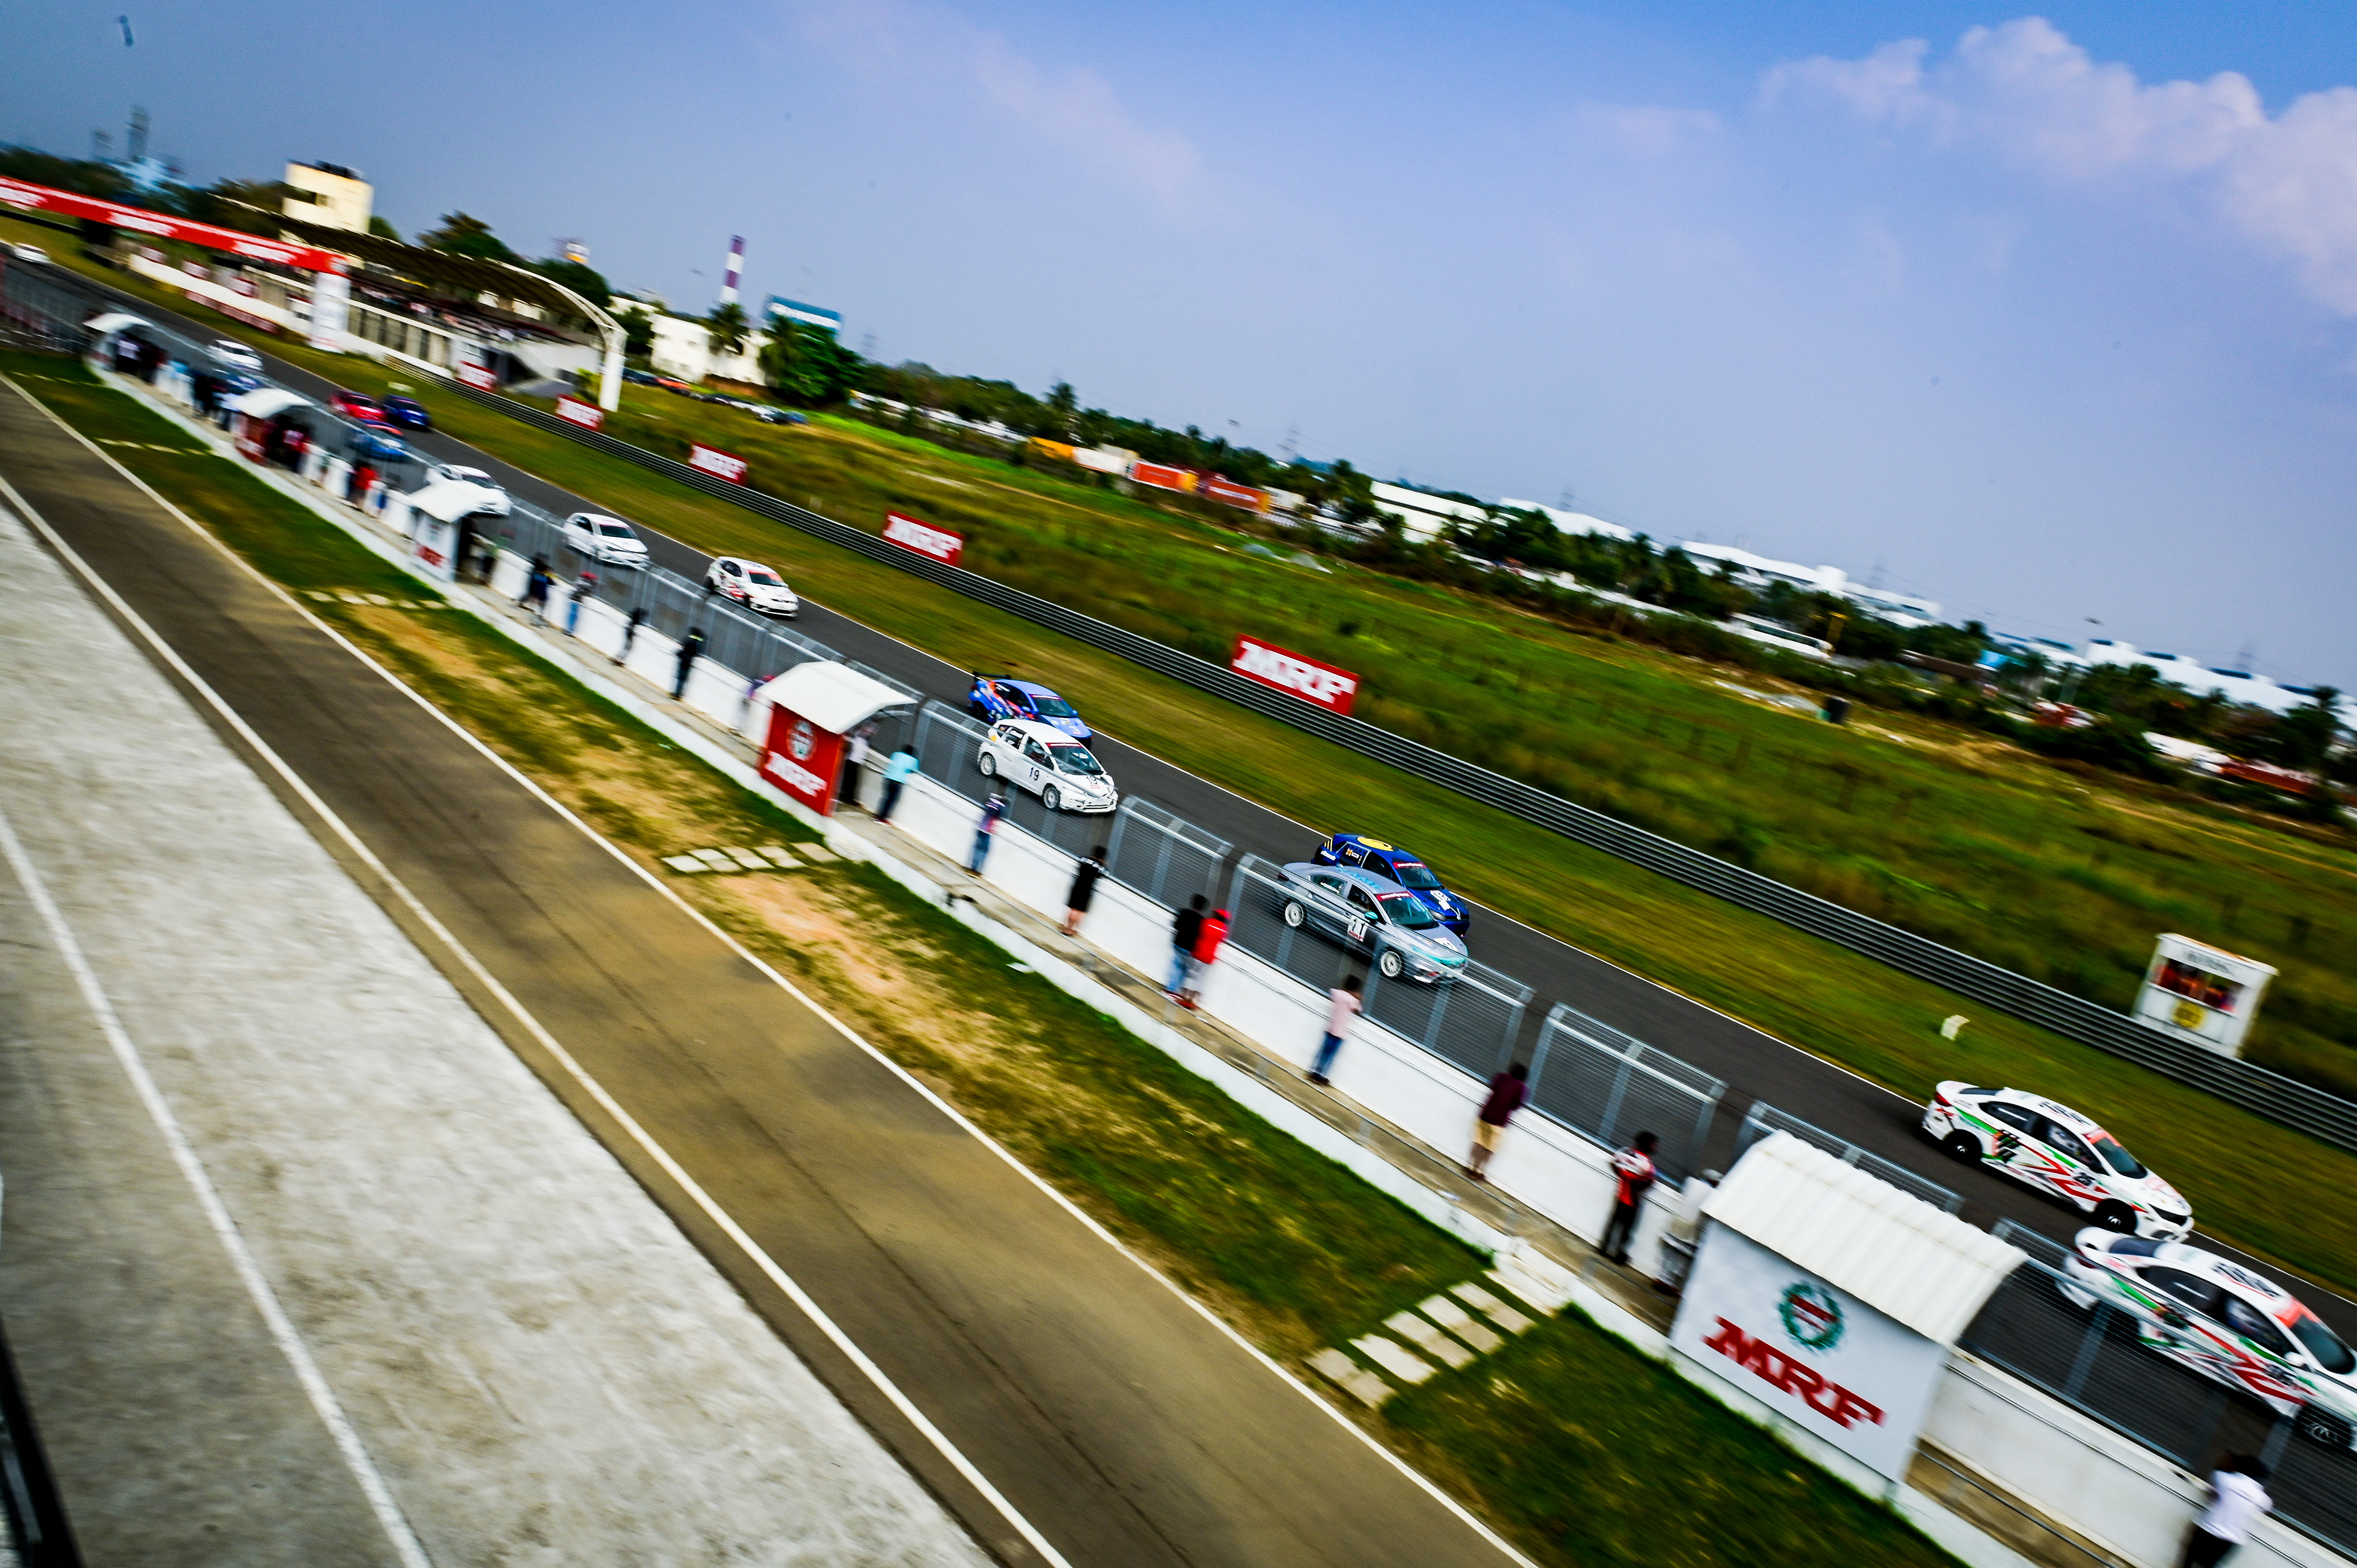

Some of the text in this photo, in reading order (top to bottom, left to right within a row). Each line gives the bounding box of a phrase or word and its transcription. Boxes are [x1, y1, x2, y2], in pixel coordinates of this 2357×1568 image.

[1233, 640, 1357, 704] MRF
[1029, 767, 1040, 781] 19
[1702, 1313, 1891, 1432] MRF
